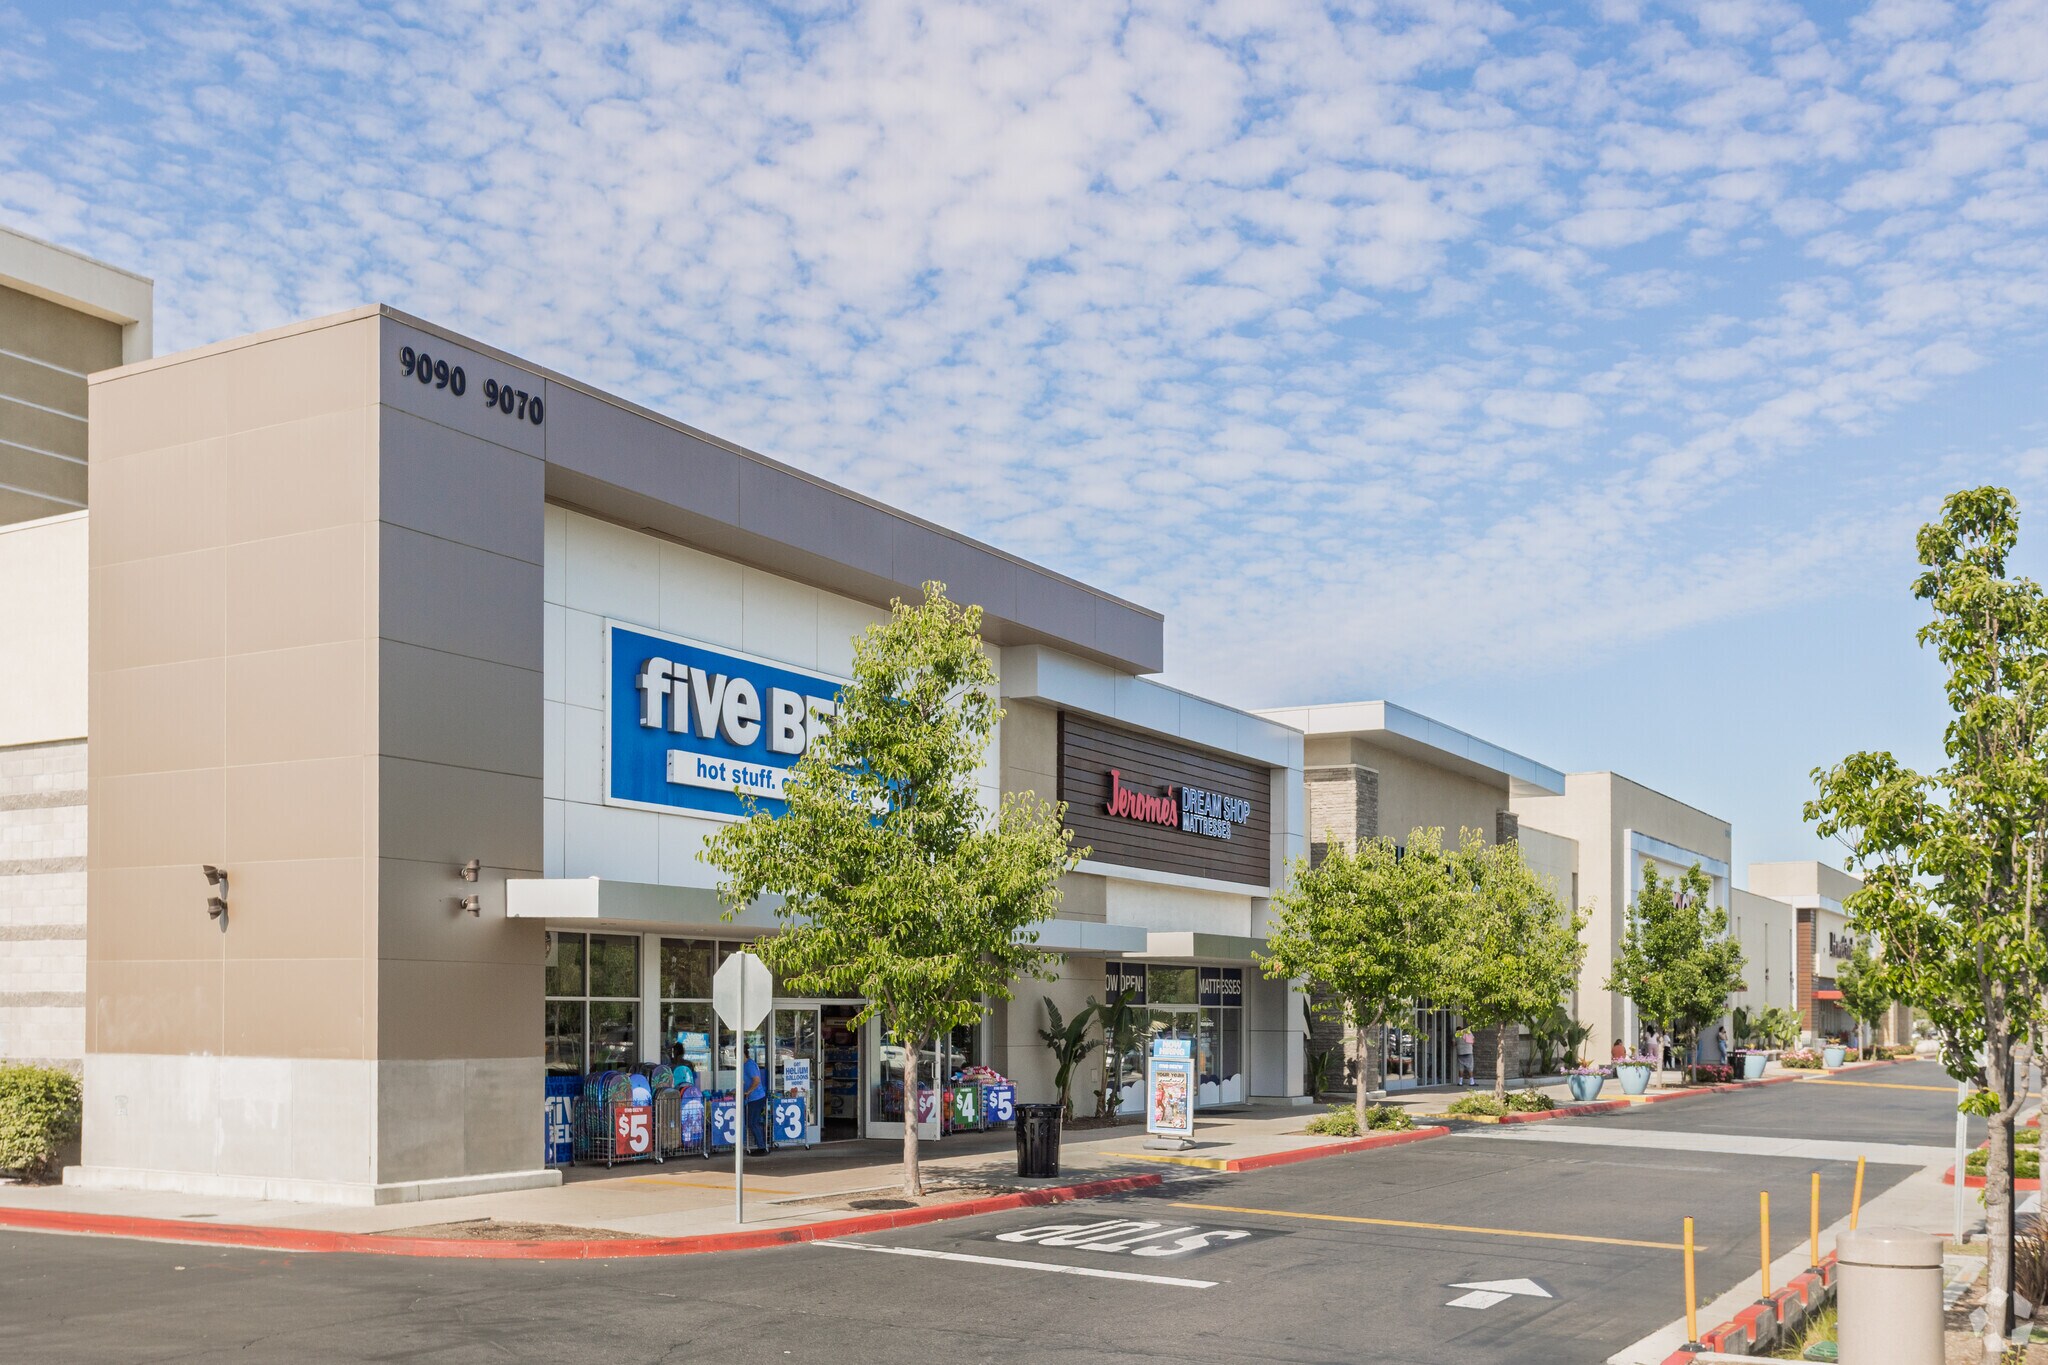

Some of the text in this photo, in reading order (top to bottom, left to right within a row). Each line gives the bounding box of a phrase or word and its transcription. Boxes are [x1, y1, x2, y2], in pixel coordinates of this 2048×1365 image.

[400, 346, 544, 425] 9090 9070
[697, 757, 726, 781] hot
[732, 767, 776, 789] stuff.
[1107, 768, 1178, 828] Jerome's
[1182, 786, 1251, 824] DREAM SHOP
[1182, 811, 1232, 840] MATTRESSES
[1105, 974, 1119, 991] OW
[776, 1104, 802, 1138] $3
[919, 1095, 937, 1123] $2
[956, 1092, 975, 1122] $4
[989, 1091, 1012, 1120] $5
[618, 1113, 649, 1152] $5
[714, 1107, 737, 1144] $3
[995, 1219, 1251, 1257] STOP
